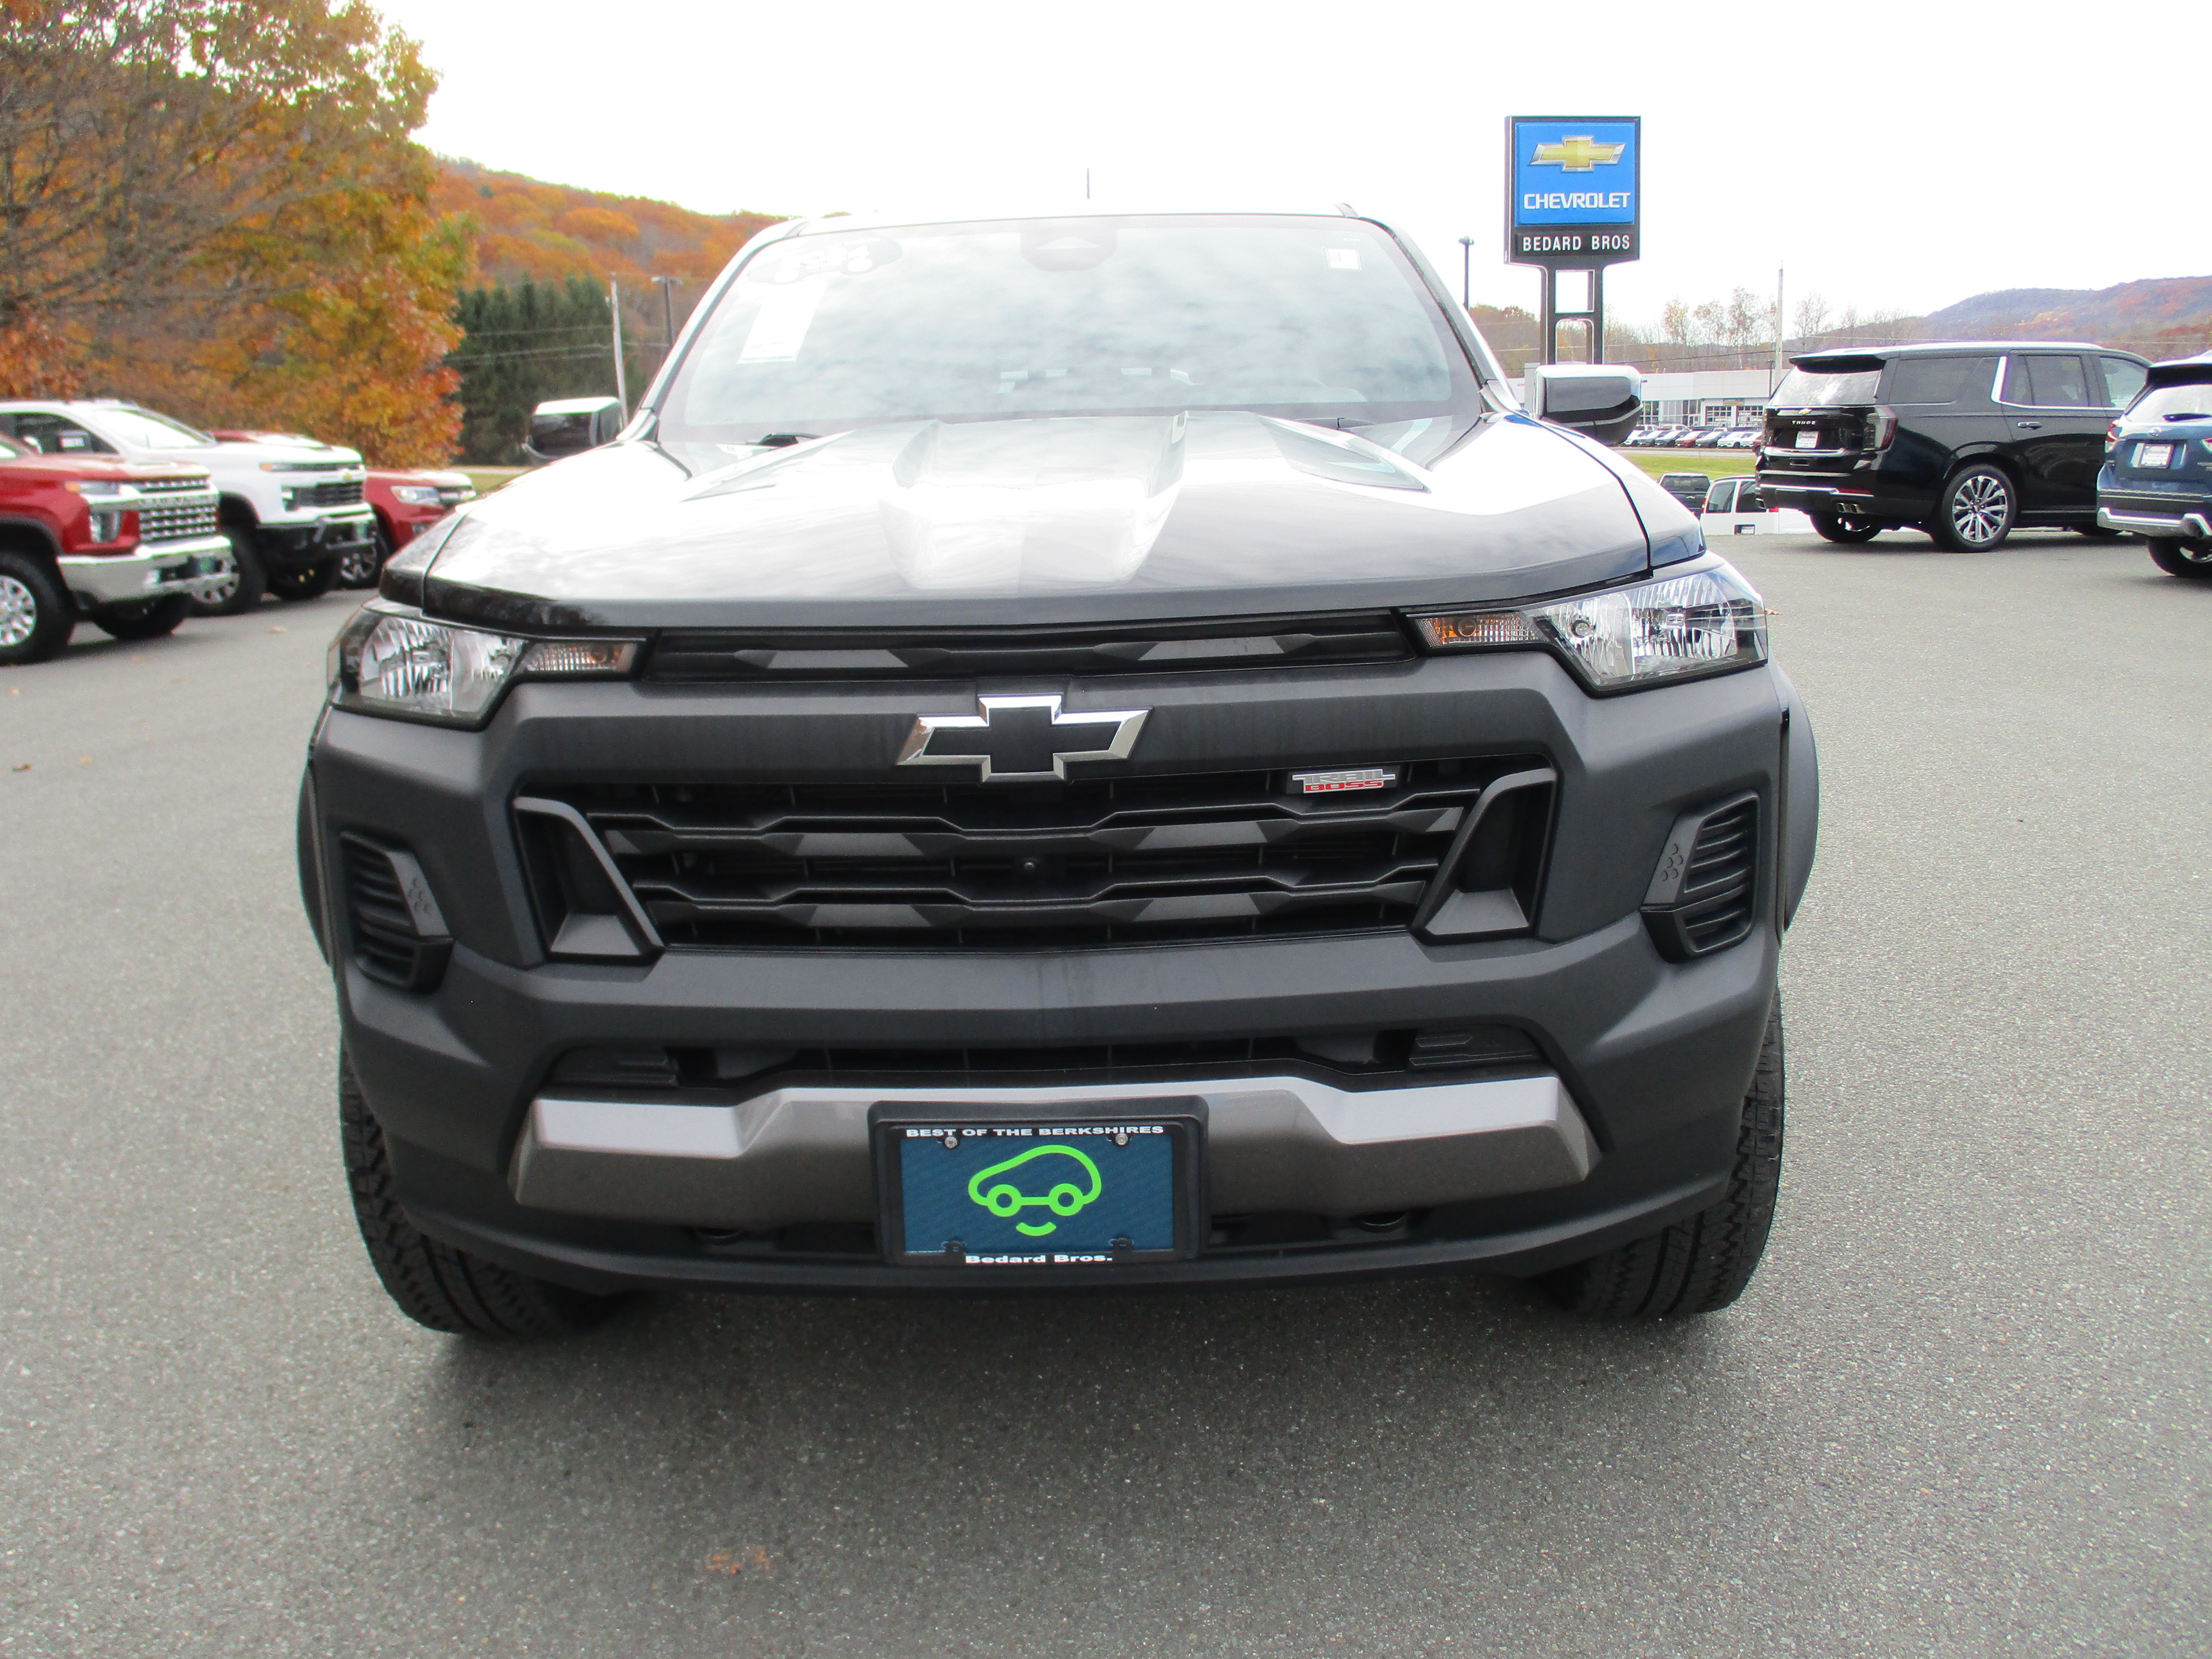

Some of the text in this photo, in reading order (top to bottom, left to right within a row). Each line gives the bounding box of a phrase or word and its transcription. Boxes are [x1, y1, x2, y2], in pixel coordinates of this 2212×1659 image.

[1524, 192, 1631, 210] CHEVROLET
[1522, 235, 1631, 252] BEDARD BROS
[1292, 769, 1396, 785] TRAIL
[1304, 780, 1384, 793] BOSS
[906, 1126, 1164, 1137] BEST OF THE BERKSHIRES
[965, 1254, 1113, 1264] Bedard Bros.
